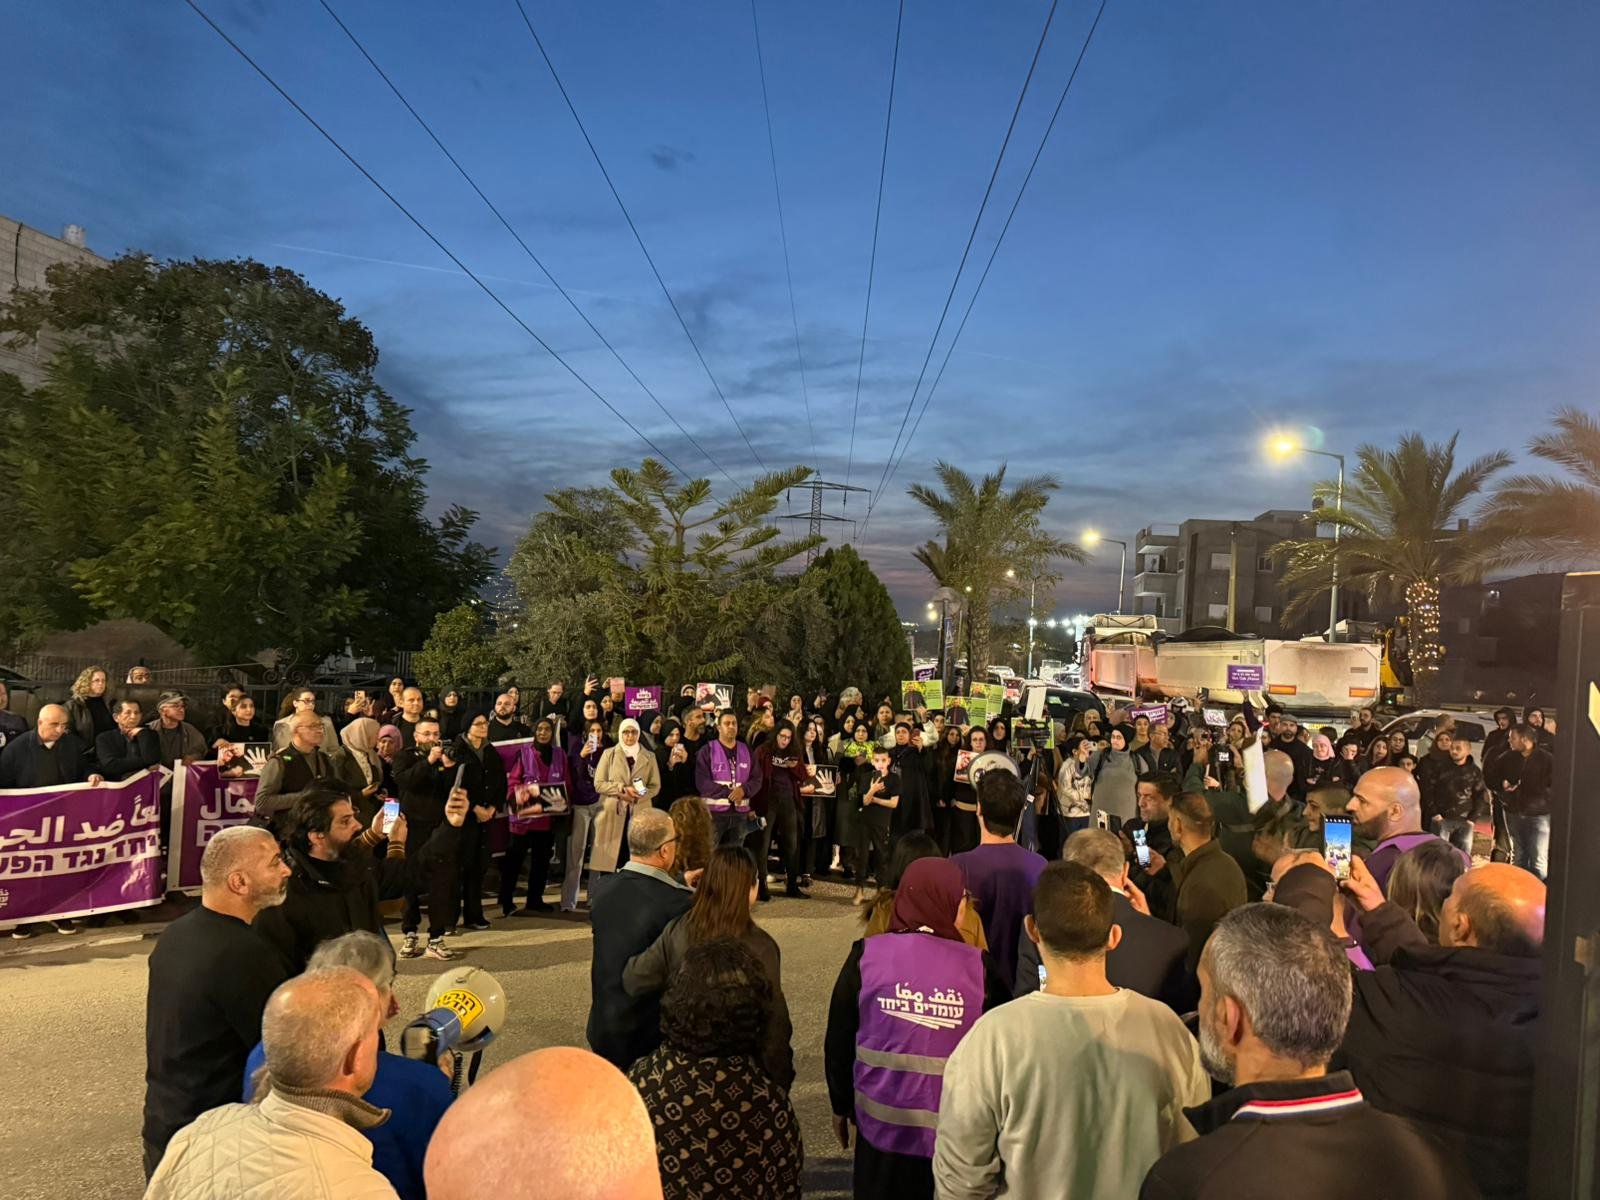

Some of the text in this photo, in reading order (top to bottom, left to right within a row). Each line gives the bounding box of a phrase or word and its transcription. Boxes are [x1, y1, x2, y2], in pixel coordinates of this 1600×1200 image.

[0, 815, 65, 851] الج
[73, 813, 126, 841] ضد
[63, 847, 106, 869] נגד
[111, 833, 161, 858] יחד
[877, 996, 965, 1019] עומדים ביחד
